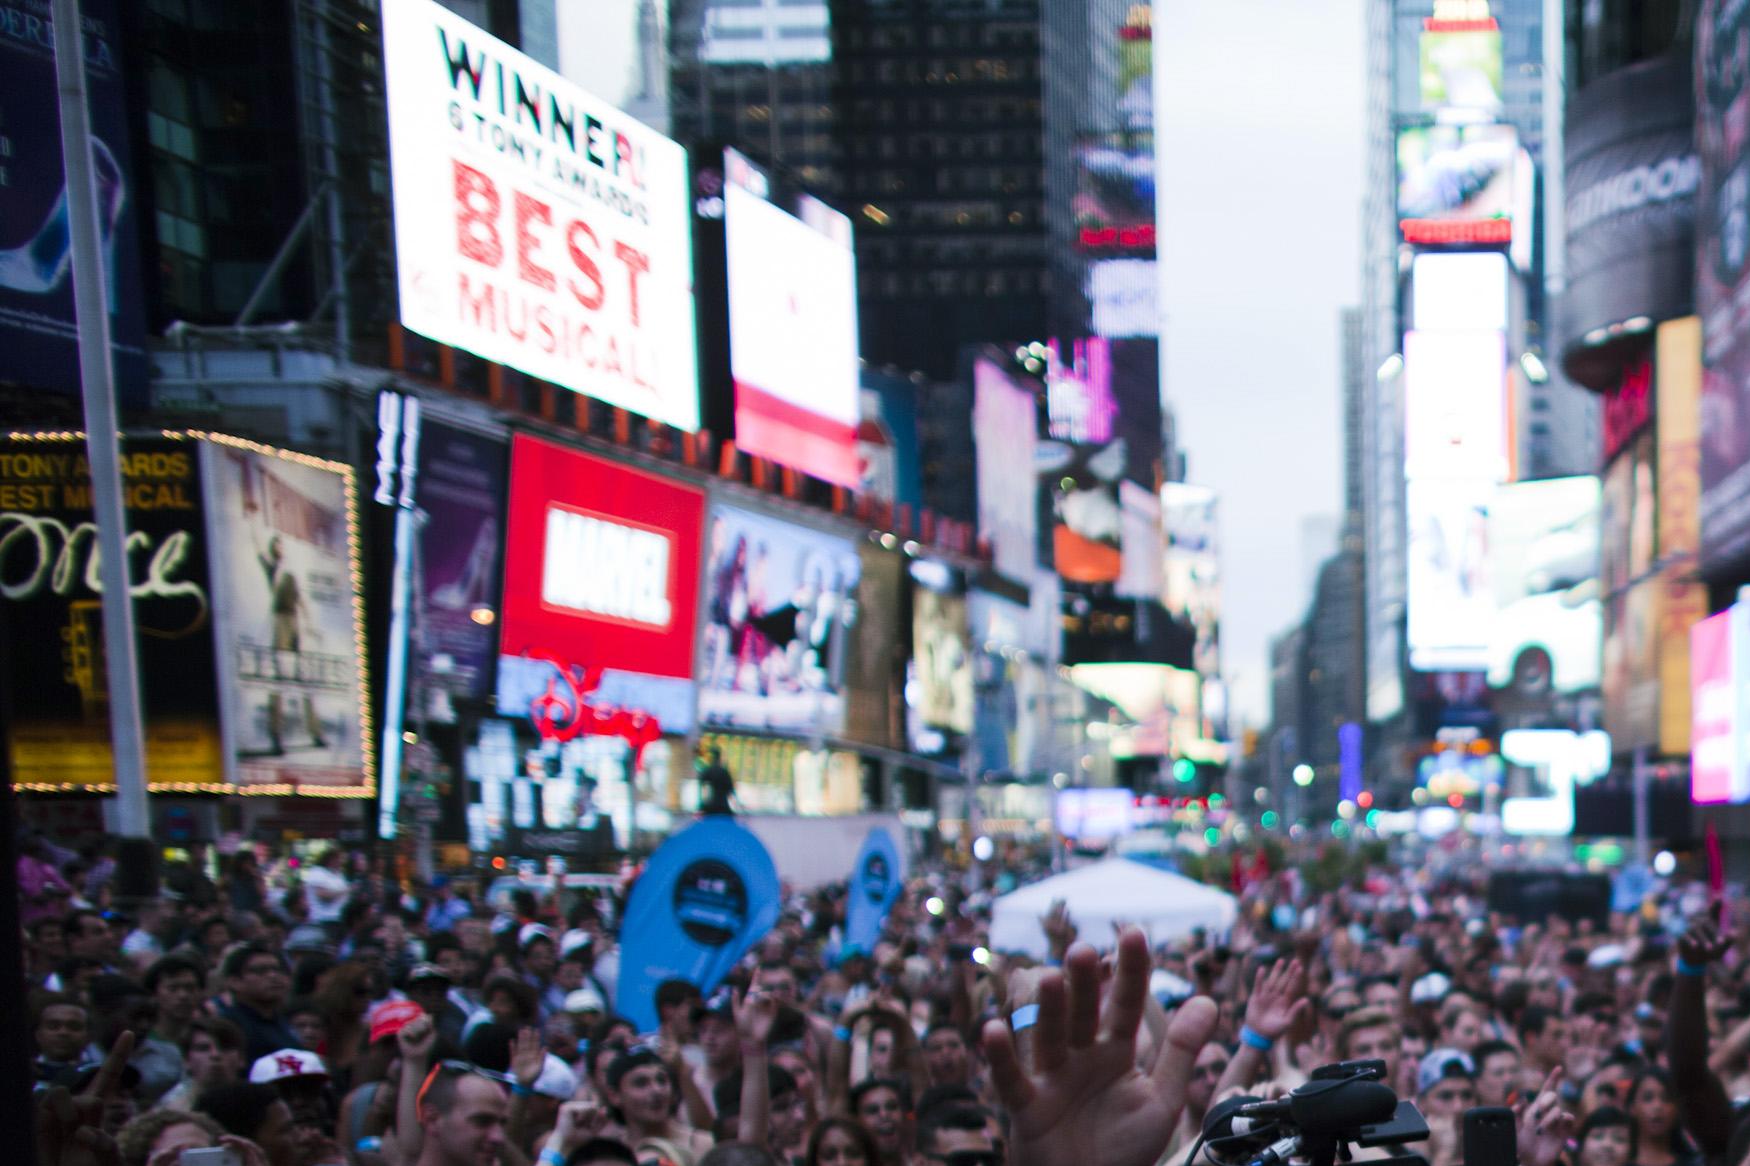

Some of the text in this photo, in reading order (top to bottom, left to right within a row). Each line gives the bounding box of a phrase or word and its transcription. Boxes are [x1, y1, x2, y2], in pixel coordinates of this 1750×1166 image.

[472, 112, 544, 174] TONY
[552, 156, 650, 227] AWARDS
[451, 157, 651, 330] BEST
[0, 453, 190, 478] TONY AARDS
[64, 485, 194, 510] MICAL
